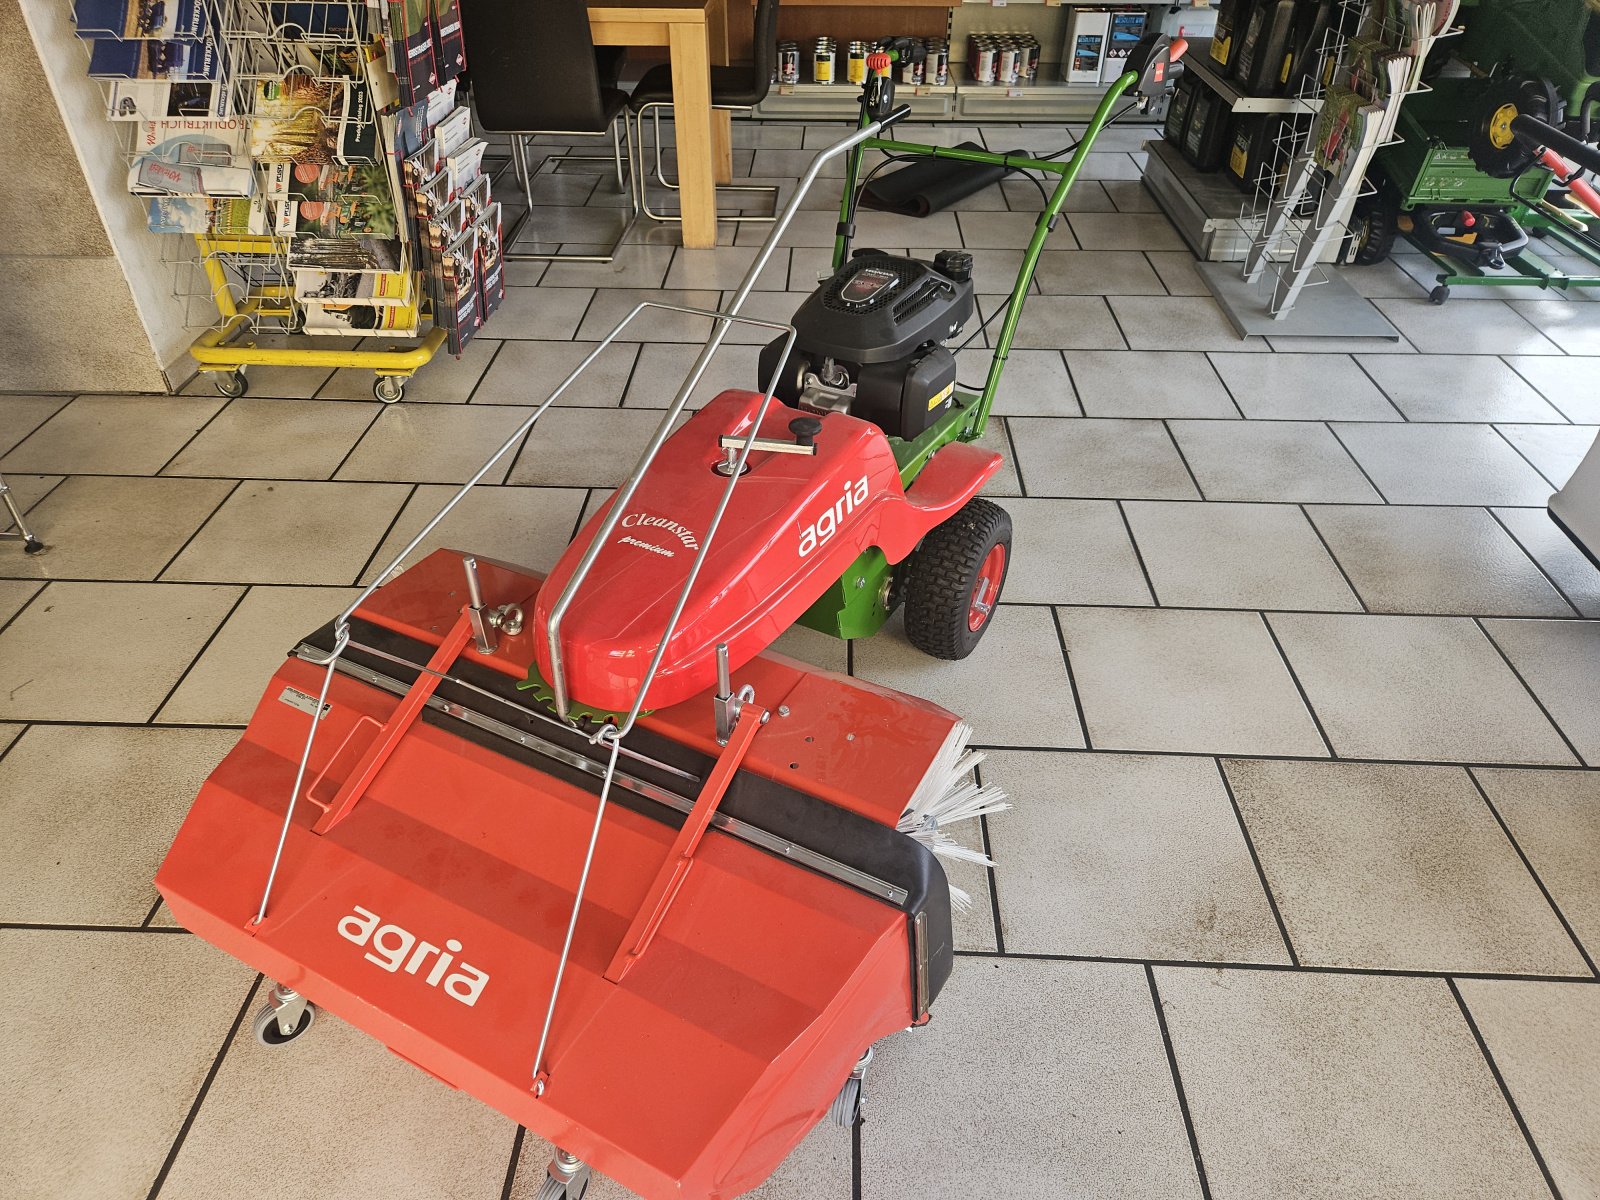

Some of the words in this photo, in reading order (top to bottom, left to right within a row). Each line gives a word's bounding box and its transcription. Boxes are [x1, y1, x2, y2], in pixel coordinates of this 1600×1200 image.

[617, 534, 675, 558] premium
[621, 512, 700, 550] Cleanstar
[798, 475, 869, 557] agria
[336, 904, 491, 1007] agria
